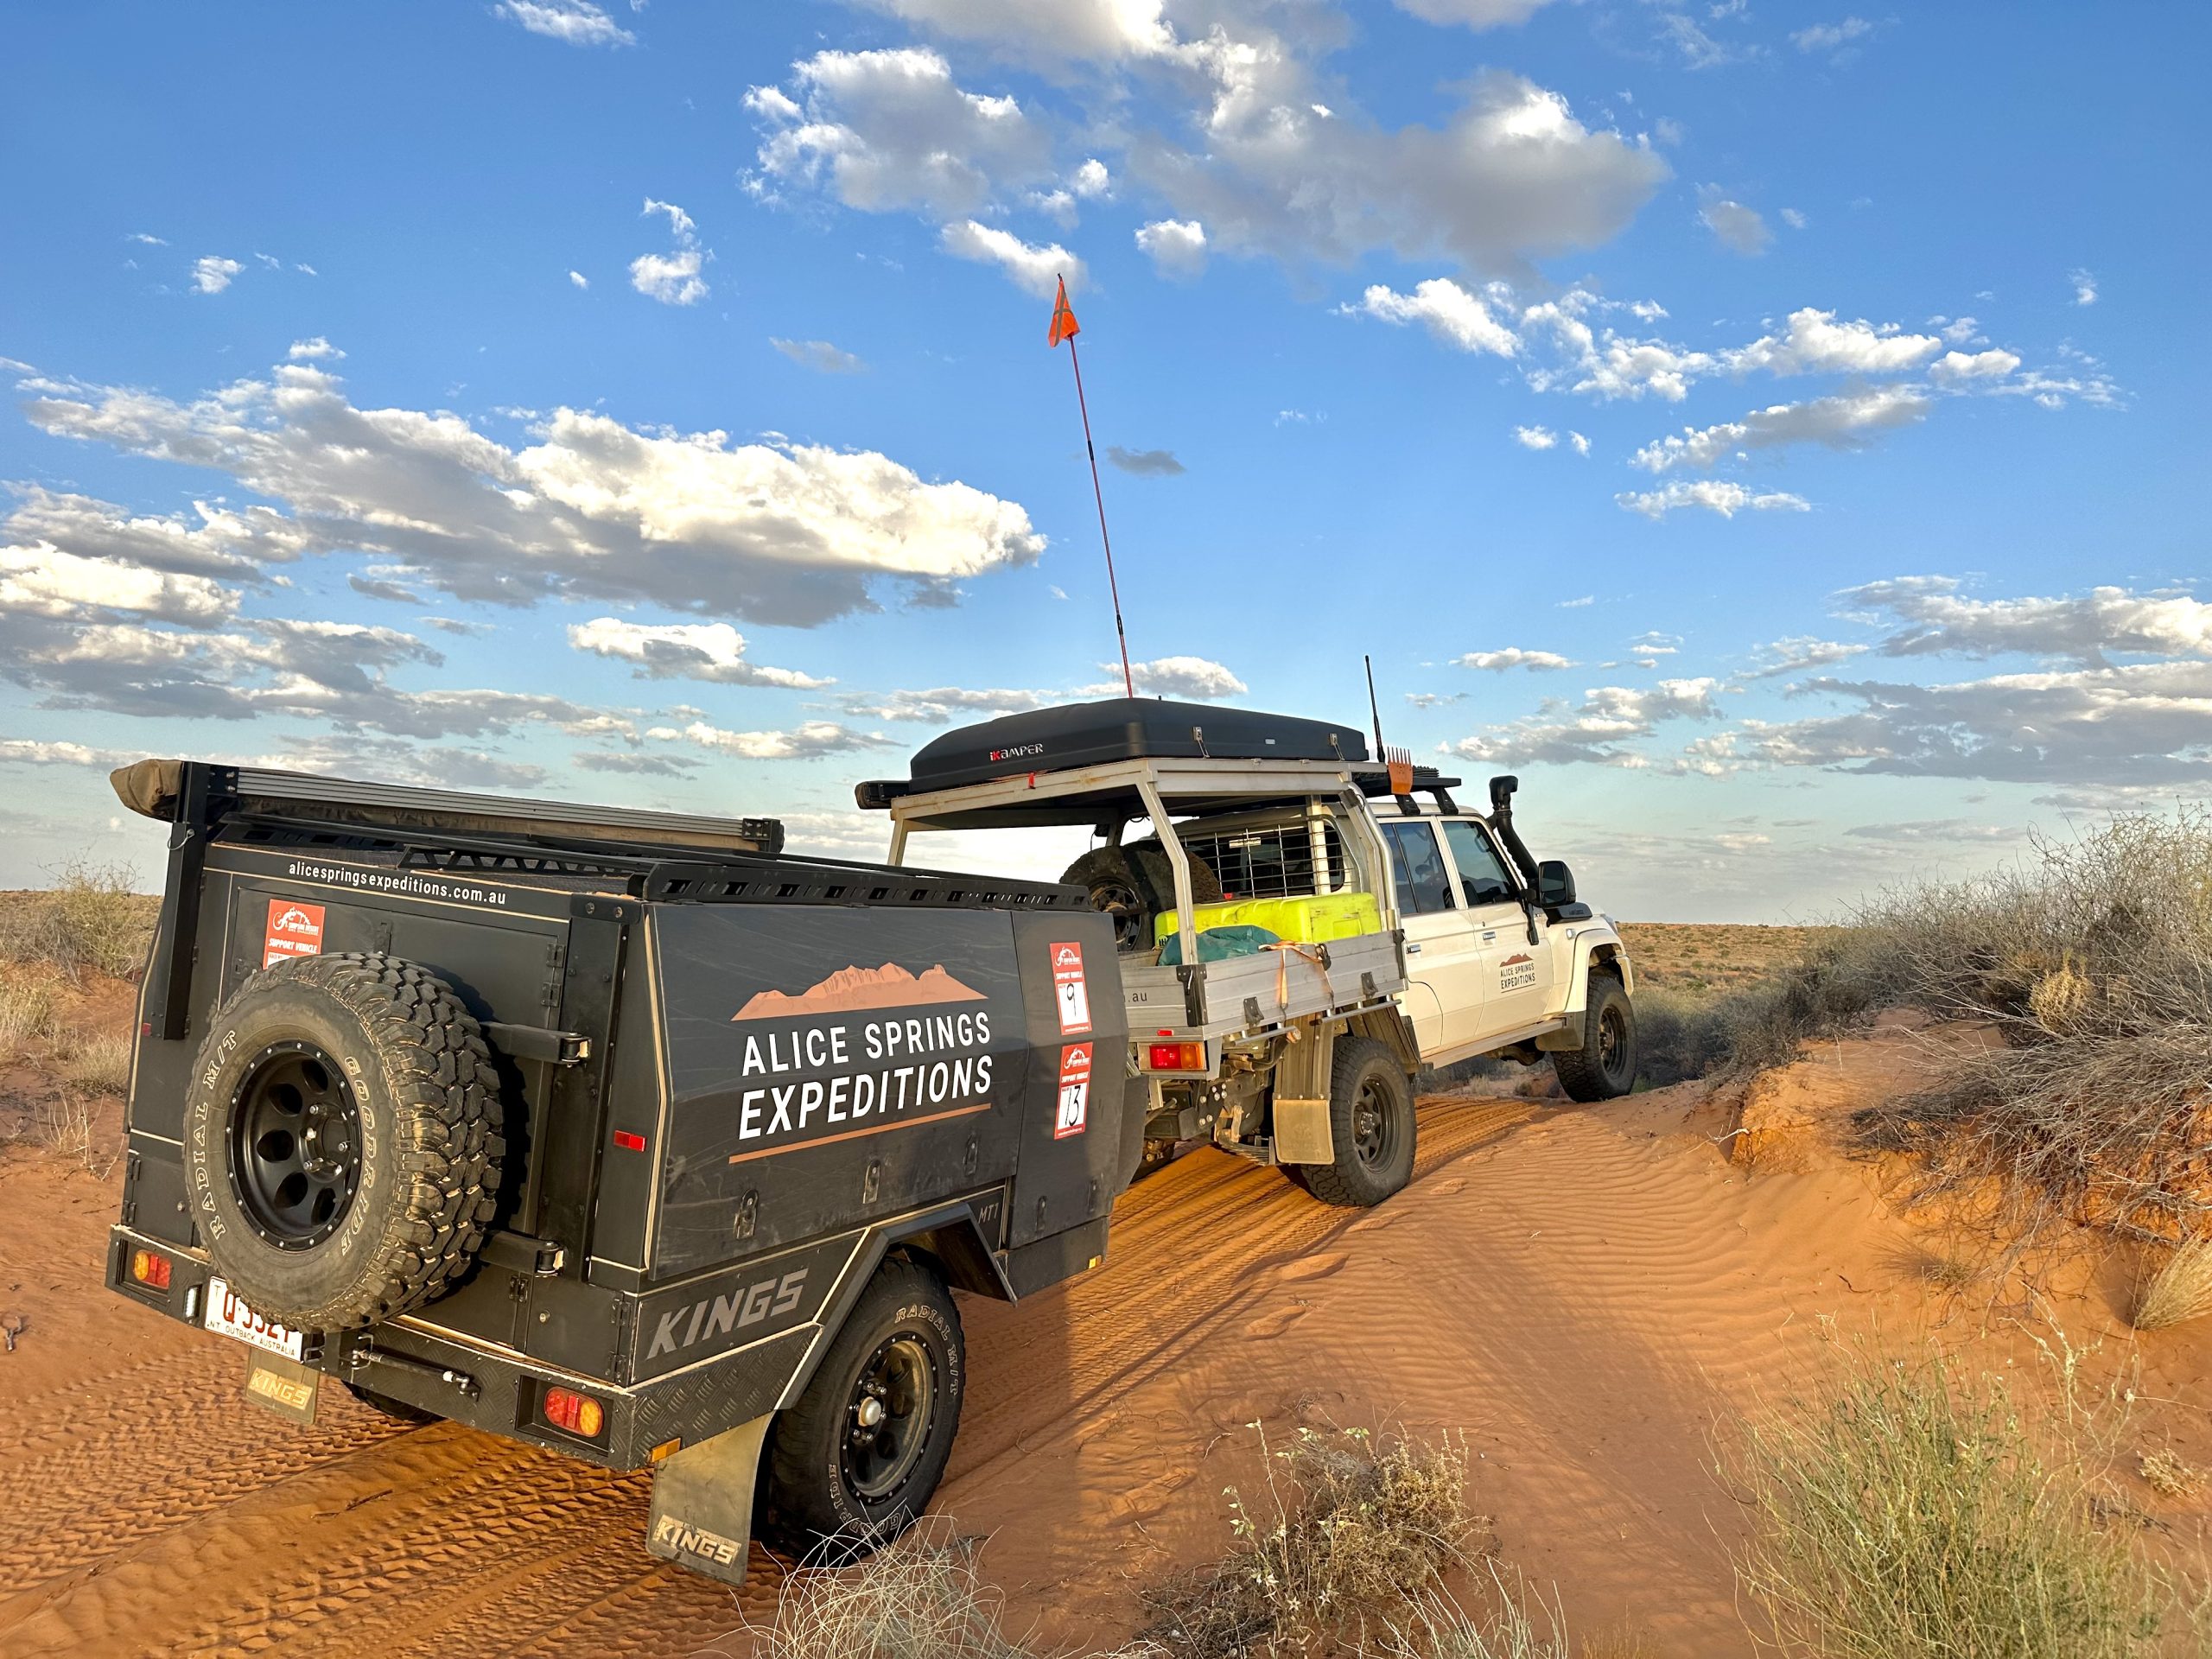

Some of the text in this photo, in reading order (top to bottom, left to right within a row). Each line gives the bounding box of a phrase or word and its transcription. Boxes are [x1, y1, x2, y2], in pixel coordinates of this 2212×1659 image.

[289, 861, 506, 905] alicespringsexpeditions.com.au
[268, 938, 318, 954] SUPPORT VEHICLE
[1500, 963, 1535, 977] ALICE SPRINGS
[1500, 972, 1535, 989] EXPEDITIONS
[1066, 982, 1077, 1016] 9
[741, 1012, 991, 1077] ALICE SPRINGS
[739, 1055, 993, 1140] EXPEDITIONS
[1065, 1084, 1081, 1127] 13
[194, 1030, 237, 1240] RADIAL M/T
[341, 1057, 377, 1255] GOODRIDE
[978, 1202, 999, 1224] MT1
[645, 1268, 809, 1360] KINGS
[894, 1303, 950, 1341] RADIAL
[226, 1325, 256, 1342] OUTBACK
[259, 1337, 296, 1357] AUSTRALIA
[251, 1372, 308, 1405] KINGS
[652, 1521, 737, 1565] KINGS
